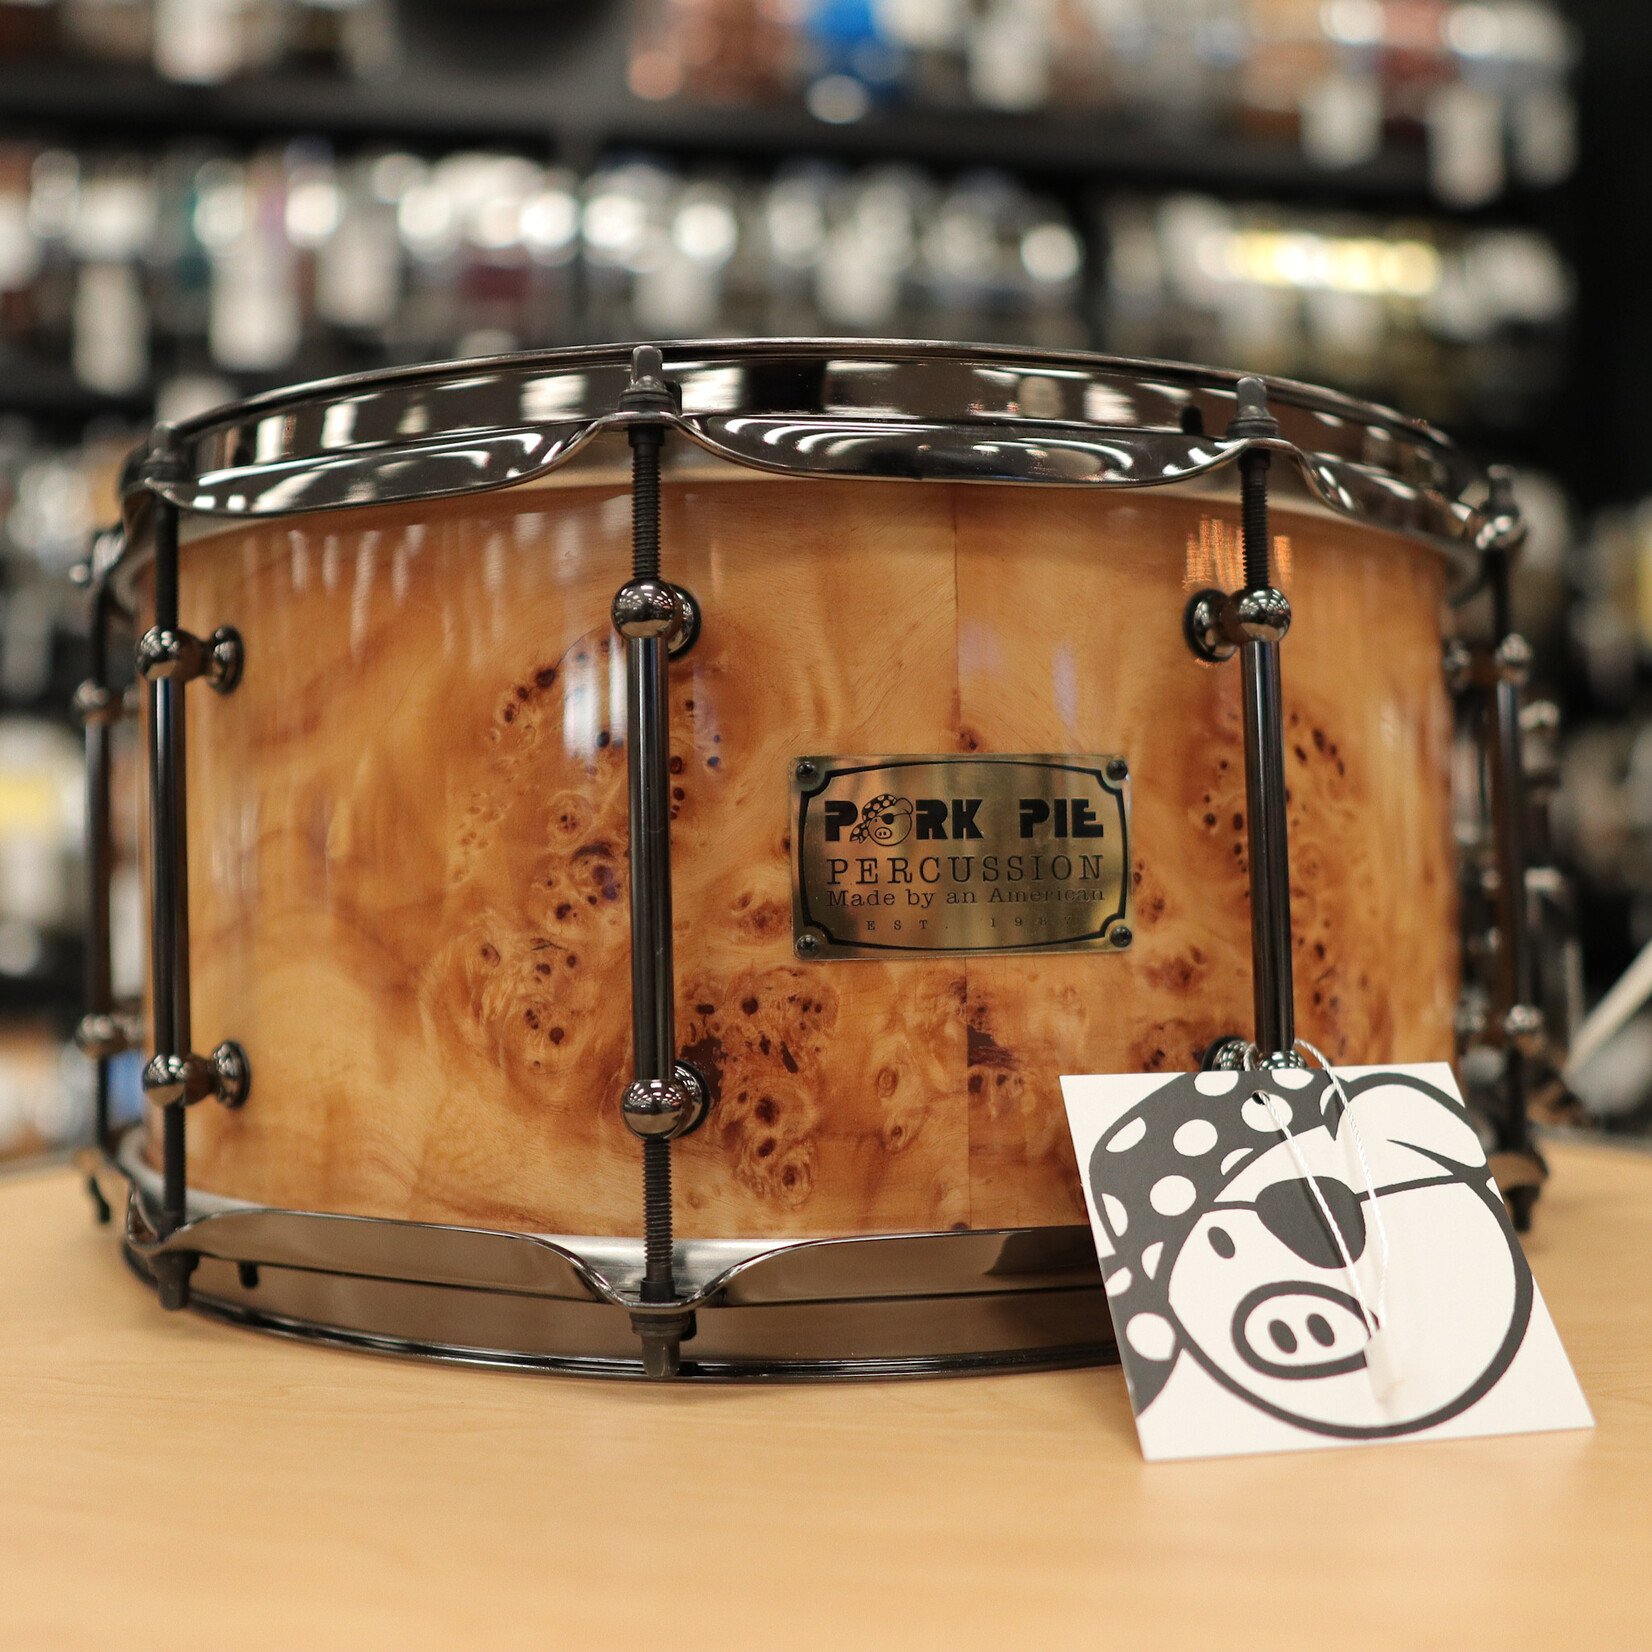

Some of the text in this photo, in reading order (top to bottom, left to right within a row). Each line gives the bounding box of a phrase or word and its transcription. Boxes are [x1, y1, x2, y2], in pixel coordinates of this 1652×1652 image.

[824, 793, 1104, 846] PORK PIE
[826, 854, 1103, 885] PERCUSSION
[826, 888, 1105, 908] Made by an American
